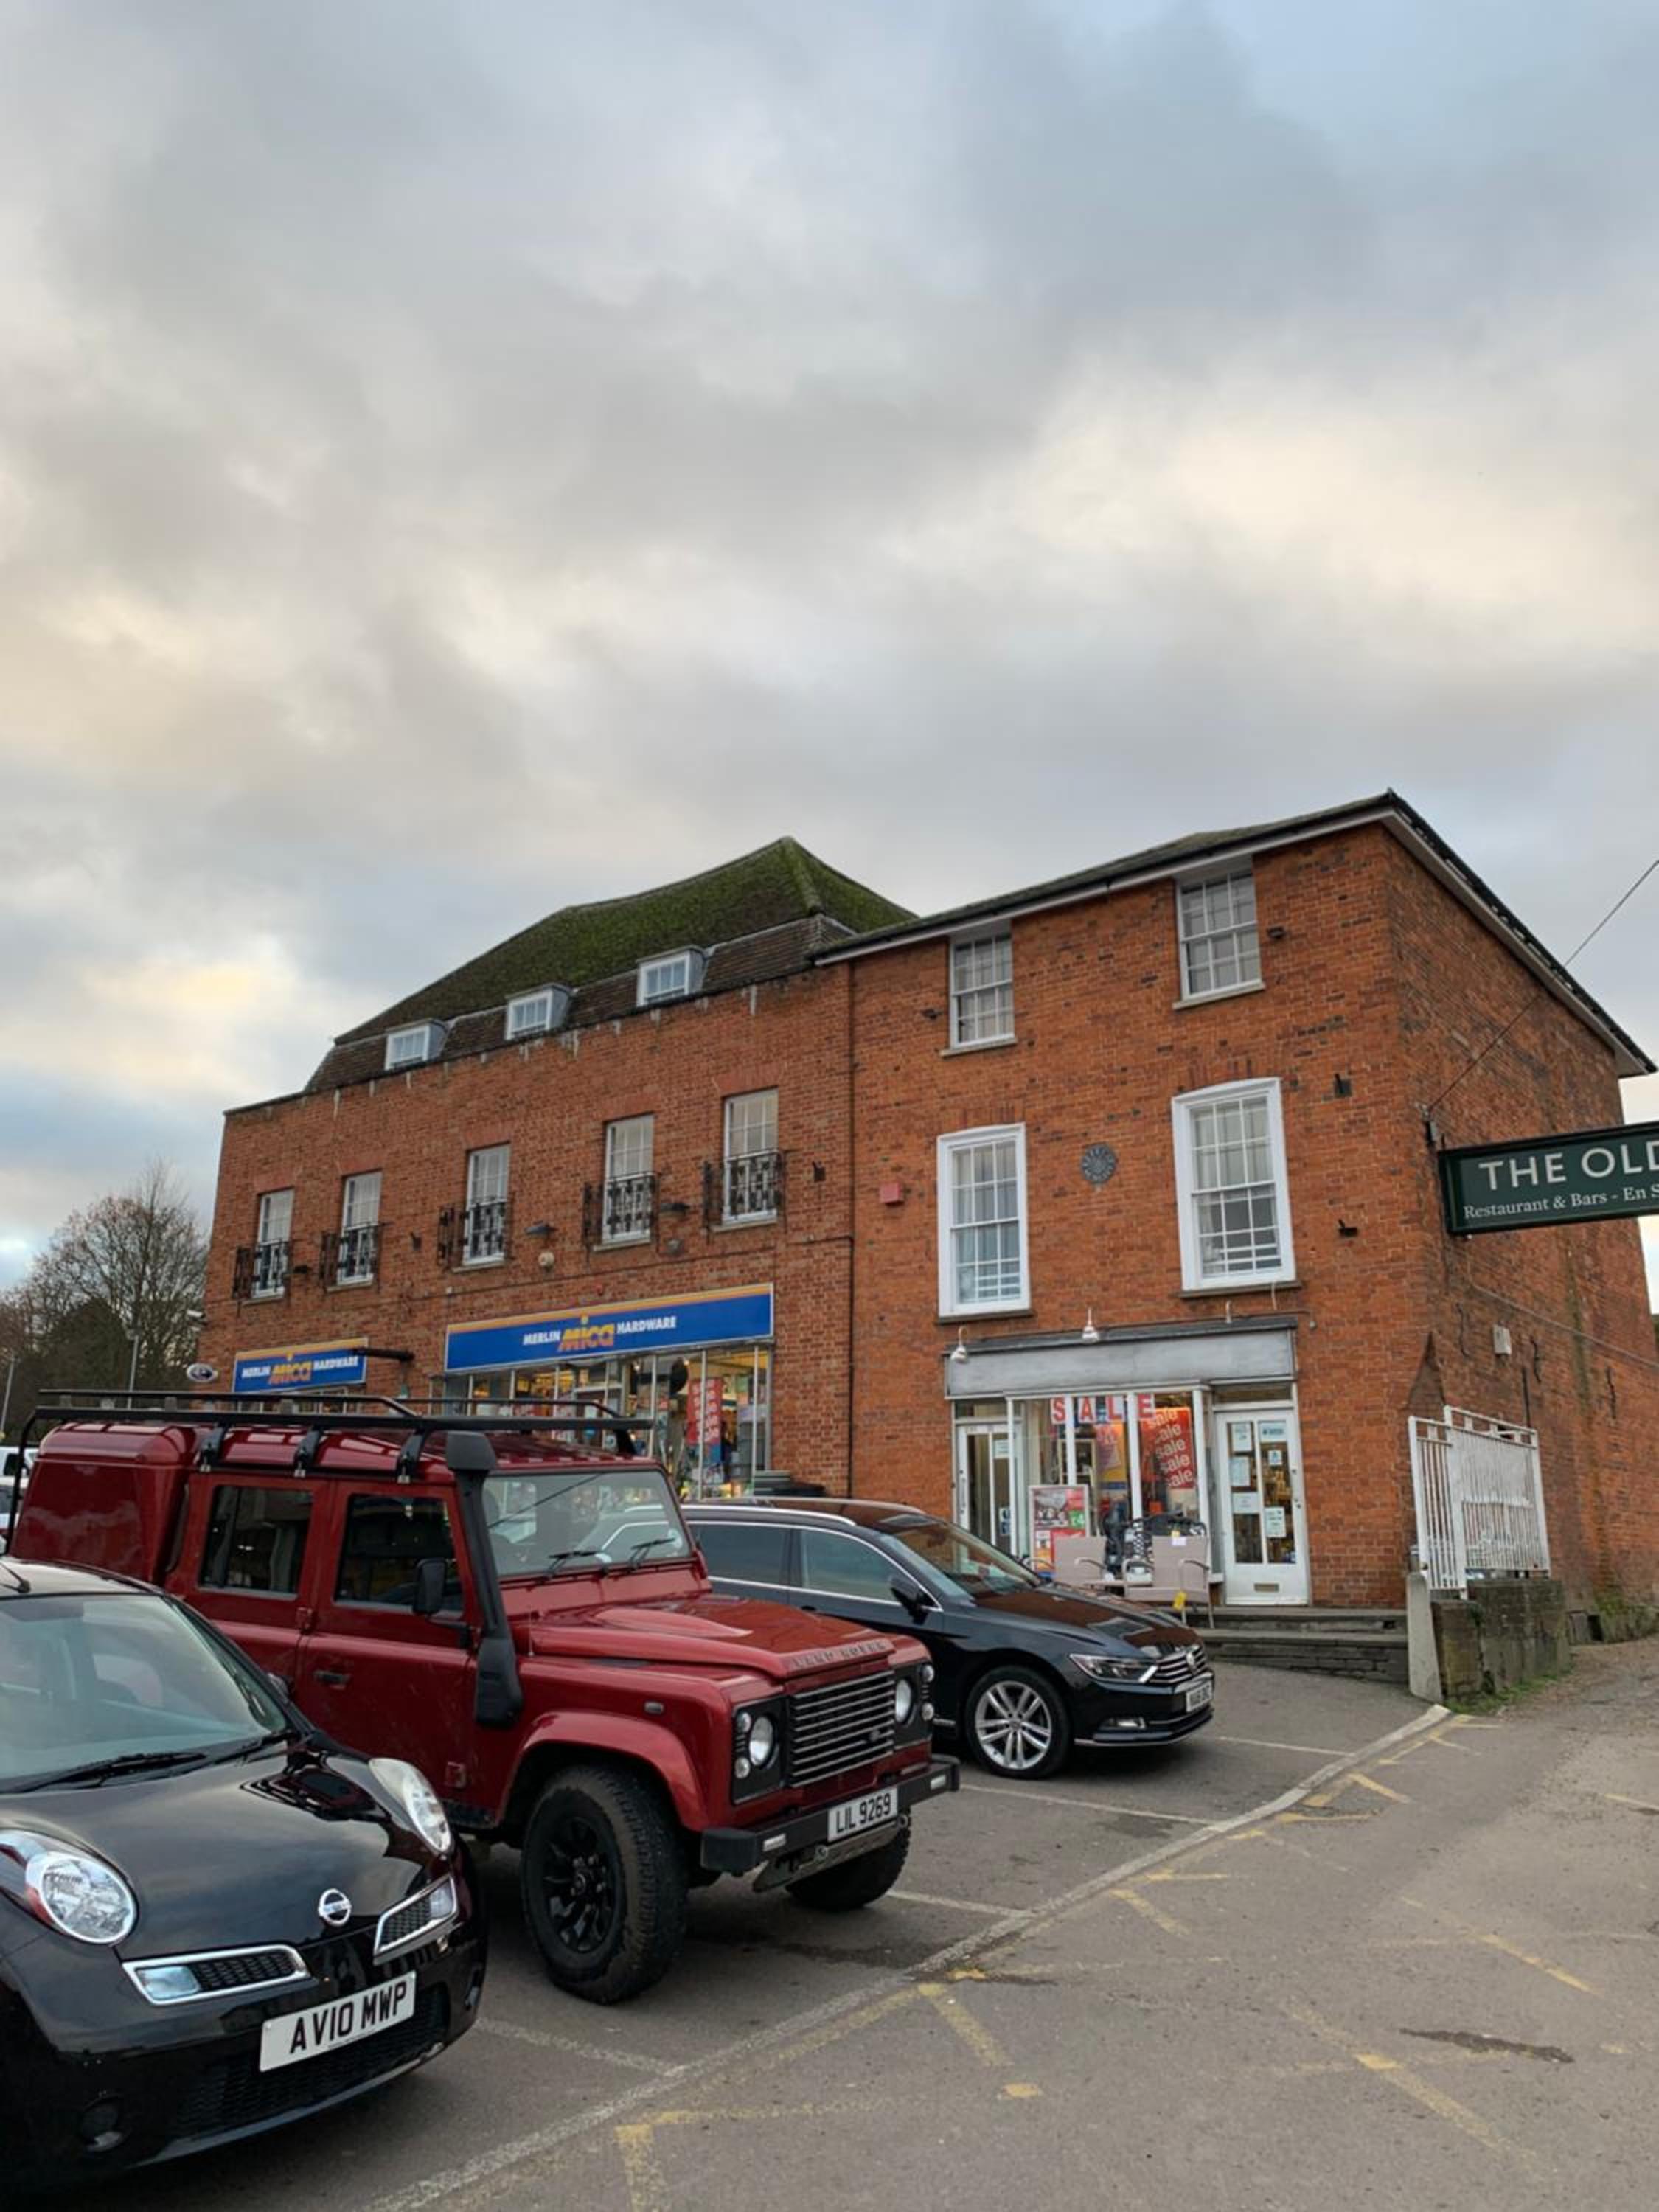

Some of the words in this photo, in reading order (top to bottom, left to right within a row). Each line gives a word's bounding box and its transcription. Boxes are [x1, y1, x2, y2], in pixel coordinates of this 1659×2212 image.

[1478, 1152, 1567, 1191] THE
[1463, 1197, 1549, 1219] Restaurant
[1553, 1195, 1566, 1209] &
[1571, 1192, 1607, 1208] Bars
[1623, 1186, 1647, 1201] En
[523, 1330, 561, 1346] MERLIN
[609, 1315, 677, 1335] HARDWARE
[241, 1366, 271, 1379] MERLIN
[313, 1356, 358, 1371] HARDWARE
[860, 1792, 891, 1824] 9269
[290, 2001, 354, 2053] AV10
[361, 1981, 406, 2030] MWP
